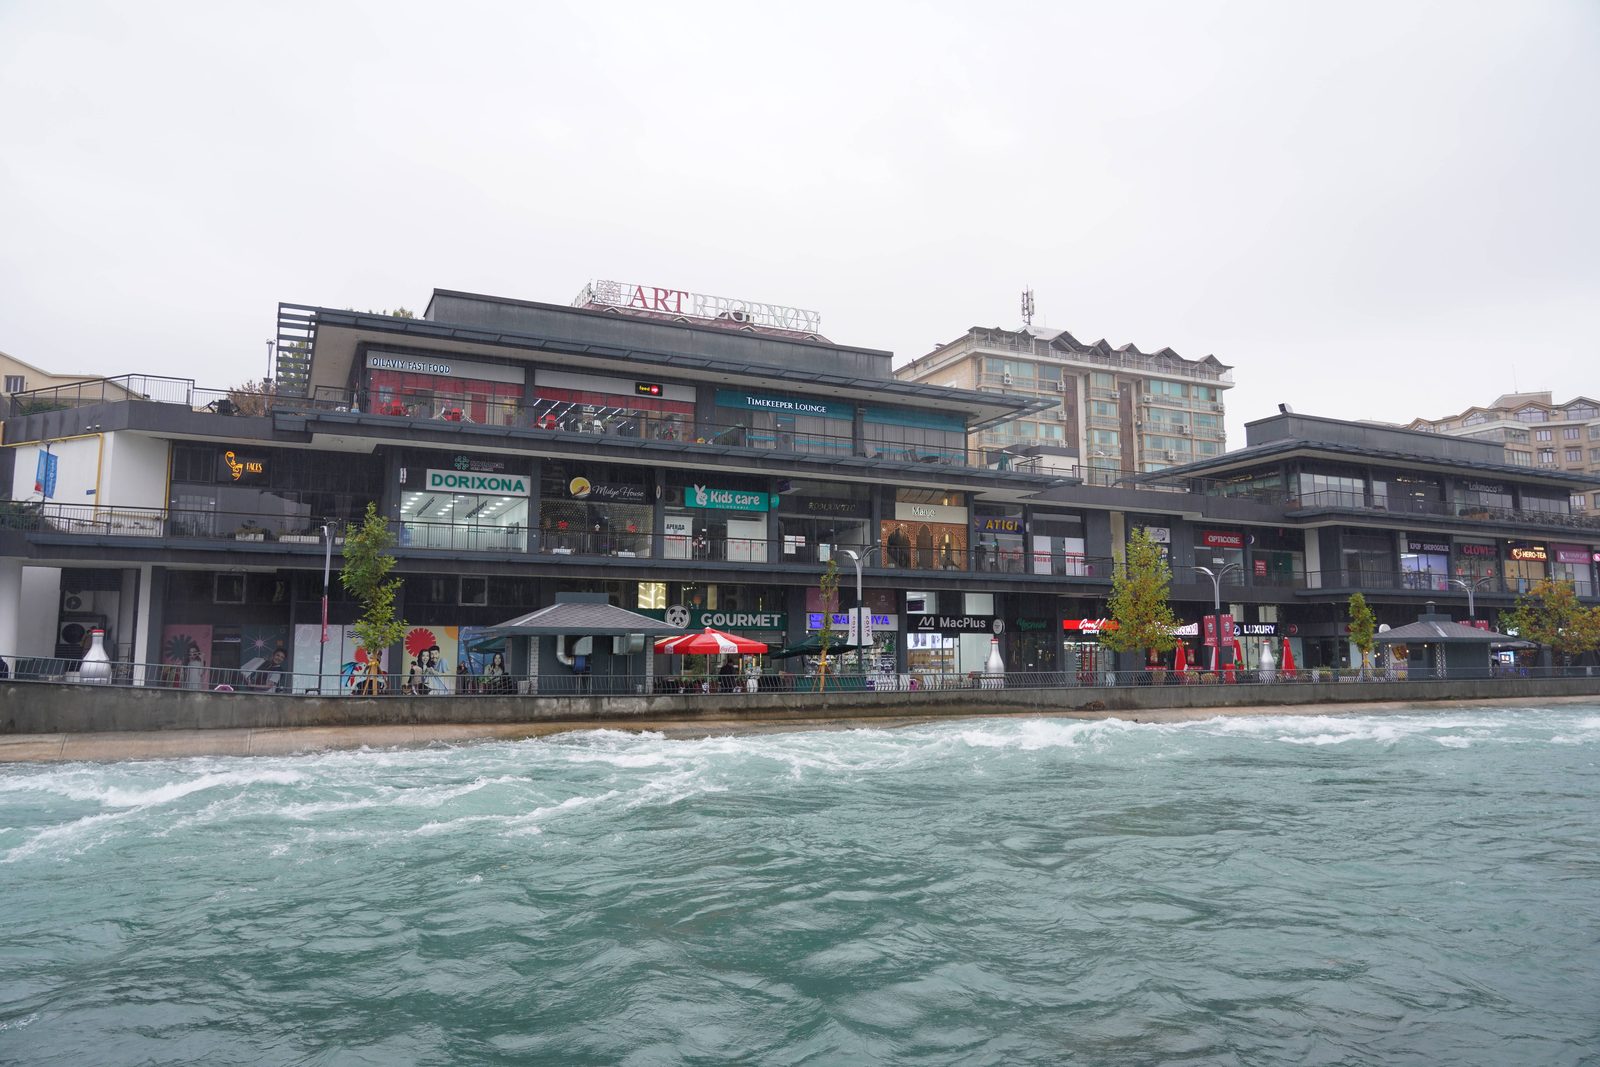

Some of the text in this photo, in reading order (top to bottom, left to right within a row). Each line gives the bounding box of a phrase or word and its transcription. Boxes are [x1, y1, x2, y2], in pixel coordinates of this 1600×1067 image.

[628, 285, 689, 314] ART
[691, 292, 819, 333] REGENCY
[372, 357, 451, 374] OILAVIY FAST FOOD
[746, 396, 827, 413] TIMEKEEPER LOUNGE
[246, 462, 262, 470] FACES
[431, 473, 526, 492] DORIXONA
[620, 486, 645, 497] House
[710, 490, 760, 506] Kids care
[808, 502, 856, 512] ROMANTIC
[665, 523, 685, 531] АРЕНДА
[985, 519, 1018, 531] ATIGI
[1207, 535, 1241, 544] OPTICORE
[1523, 550, 1547, 560] HERO-TEA
[701, 613, 782, 627] GOURMET
[940, 616, 987, 628] MacPlus
[1243, 624, 1276, 634] LUXURY
